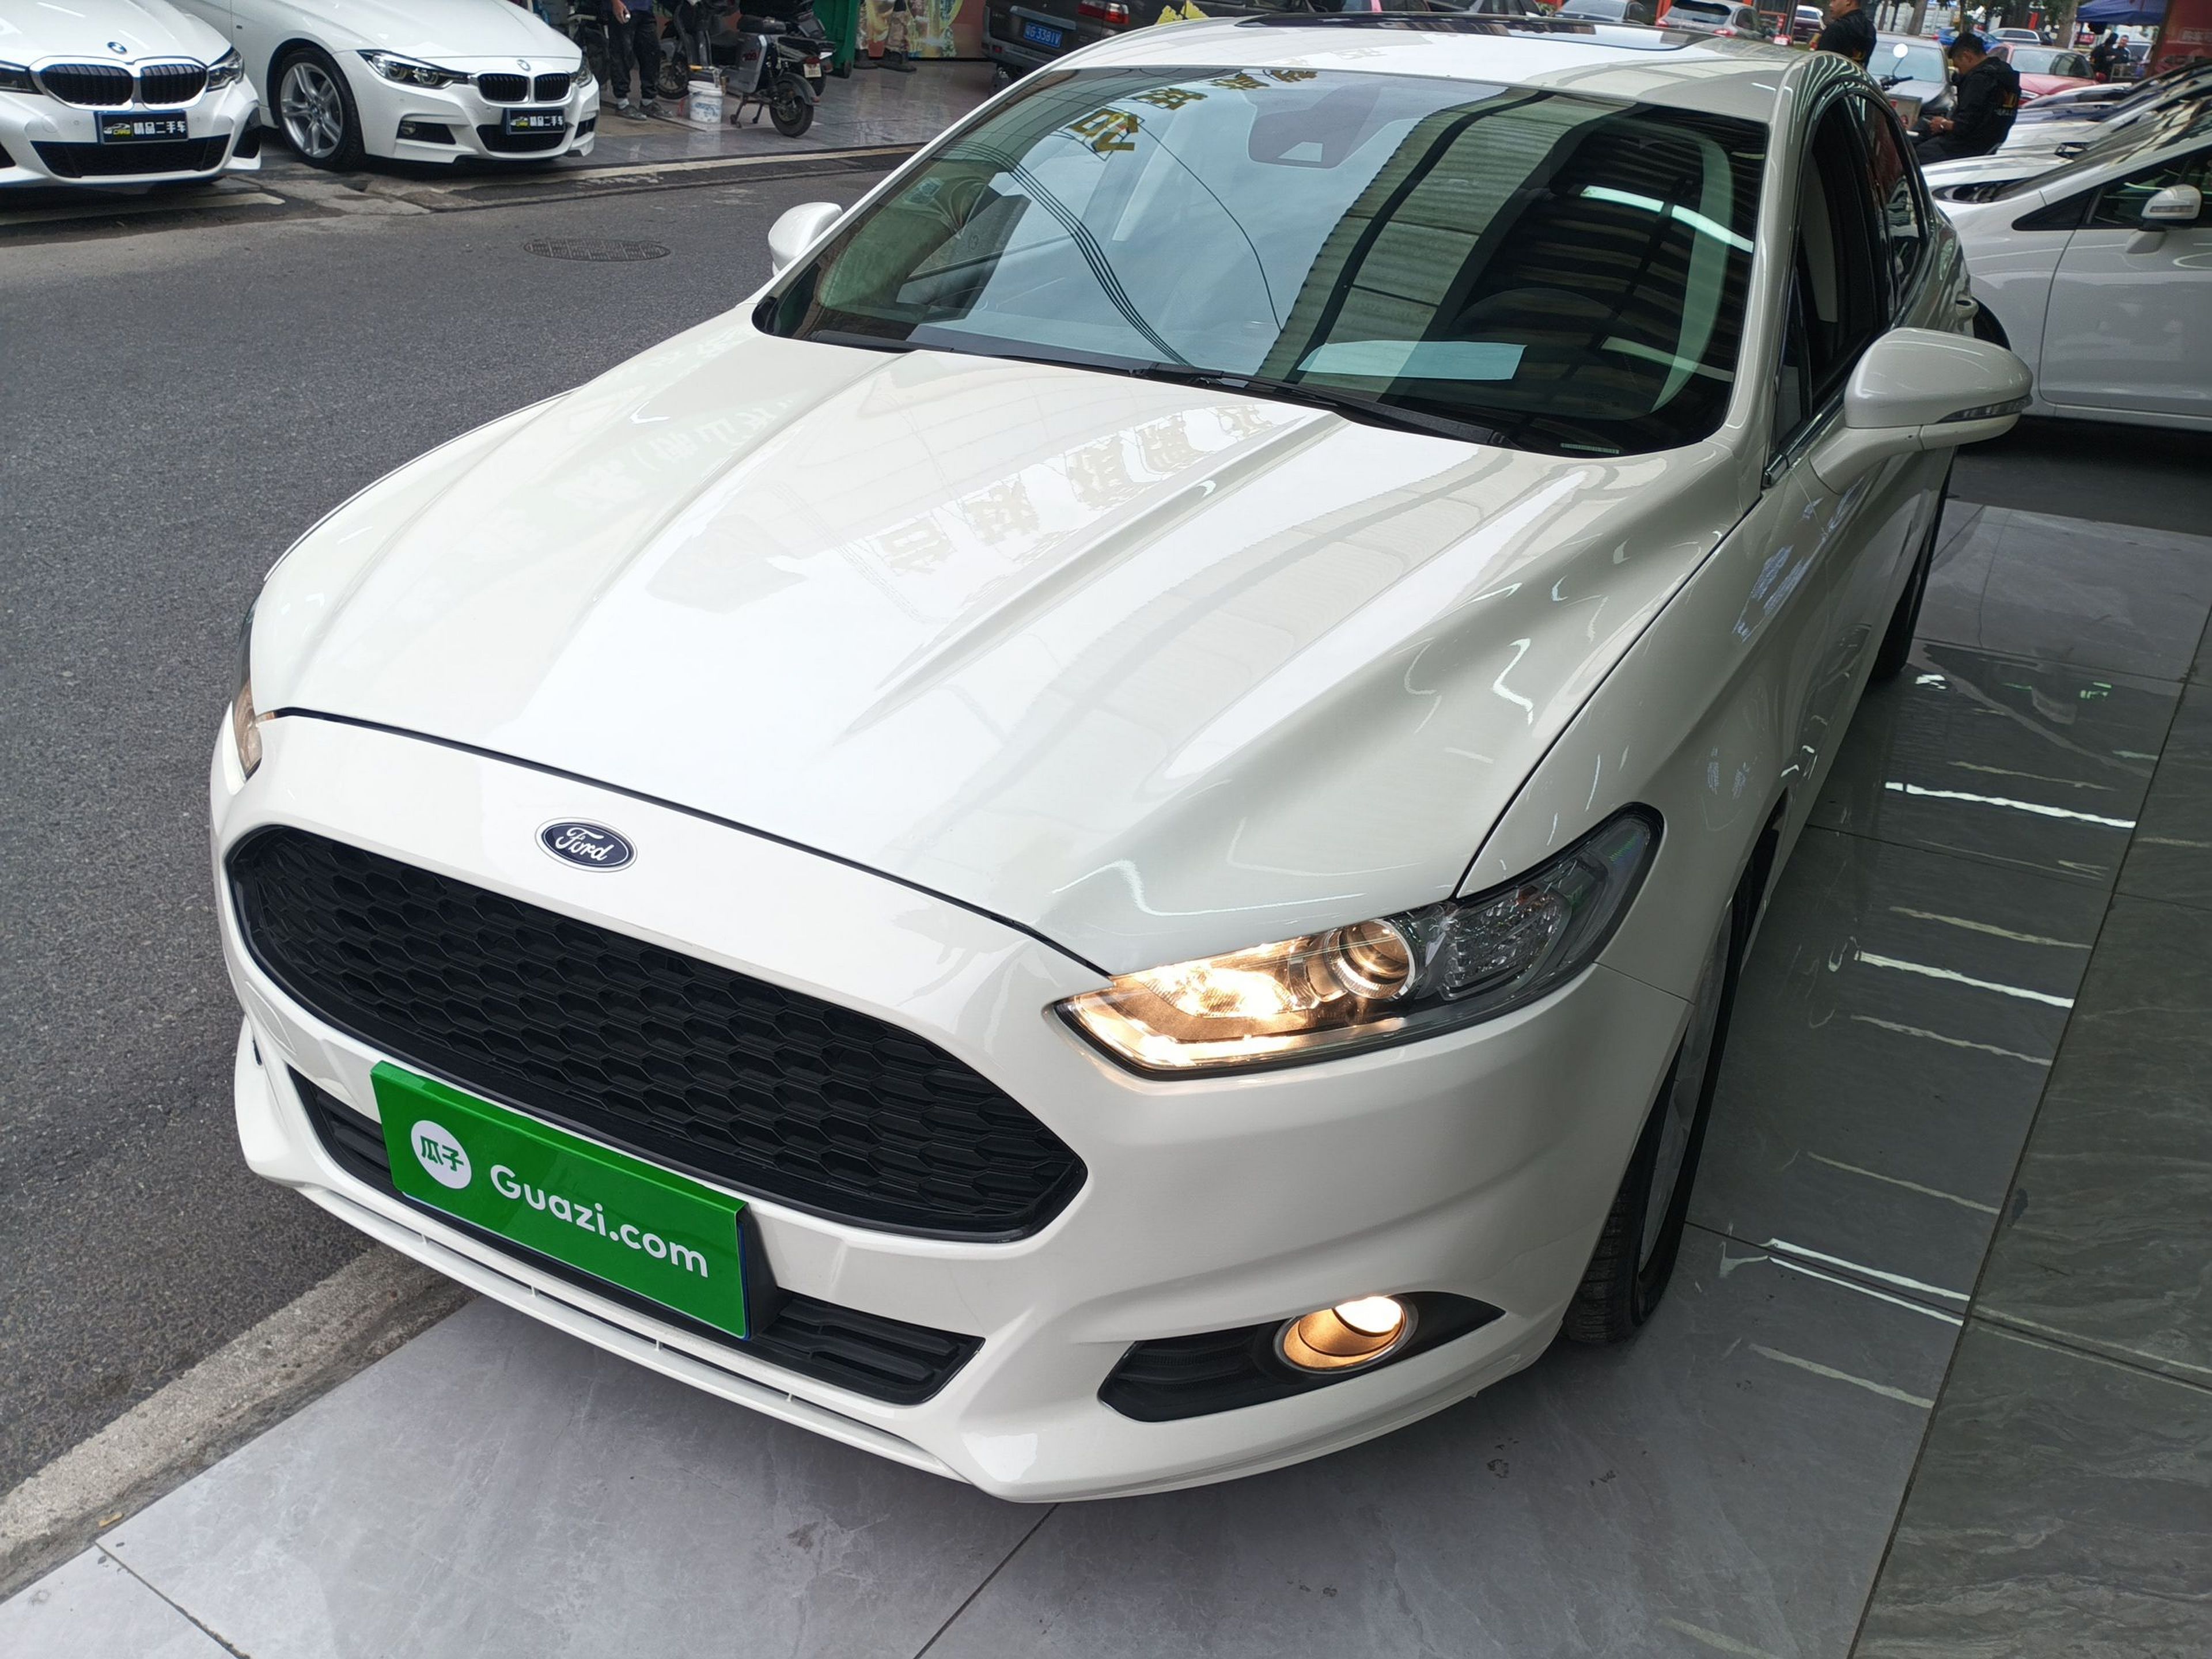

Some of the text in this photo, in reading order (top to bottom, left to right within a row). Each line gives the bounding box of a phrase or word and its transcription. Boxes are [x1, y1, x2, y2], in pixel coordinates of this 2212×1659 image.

[134, 120, 186, 135] 精品二手车
[555, 827, 615, 861] Ford
[420, 1134, 464, 1173] 瓜子
[489, 1164, 709, 1279] Guazi.com
